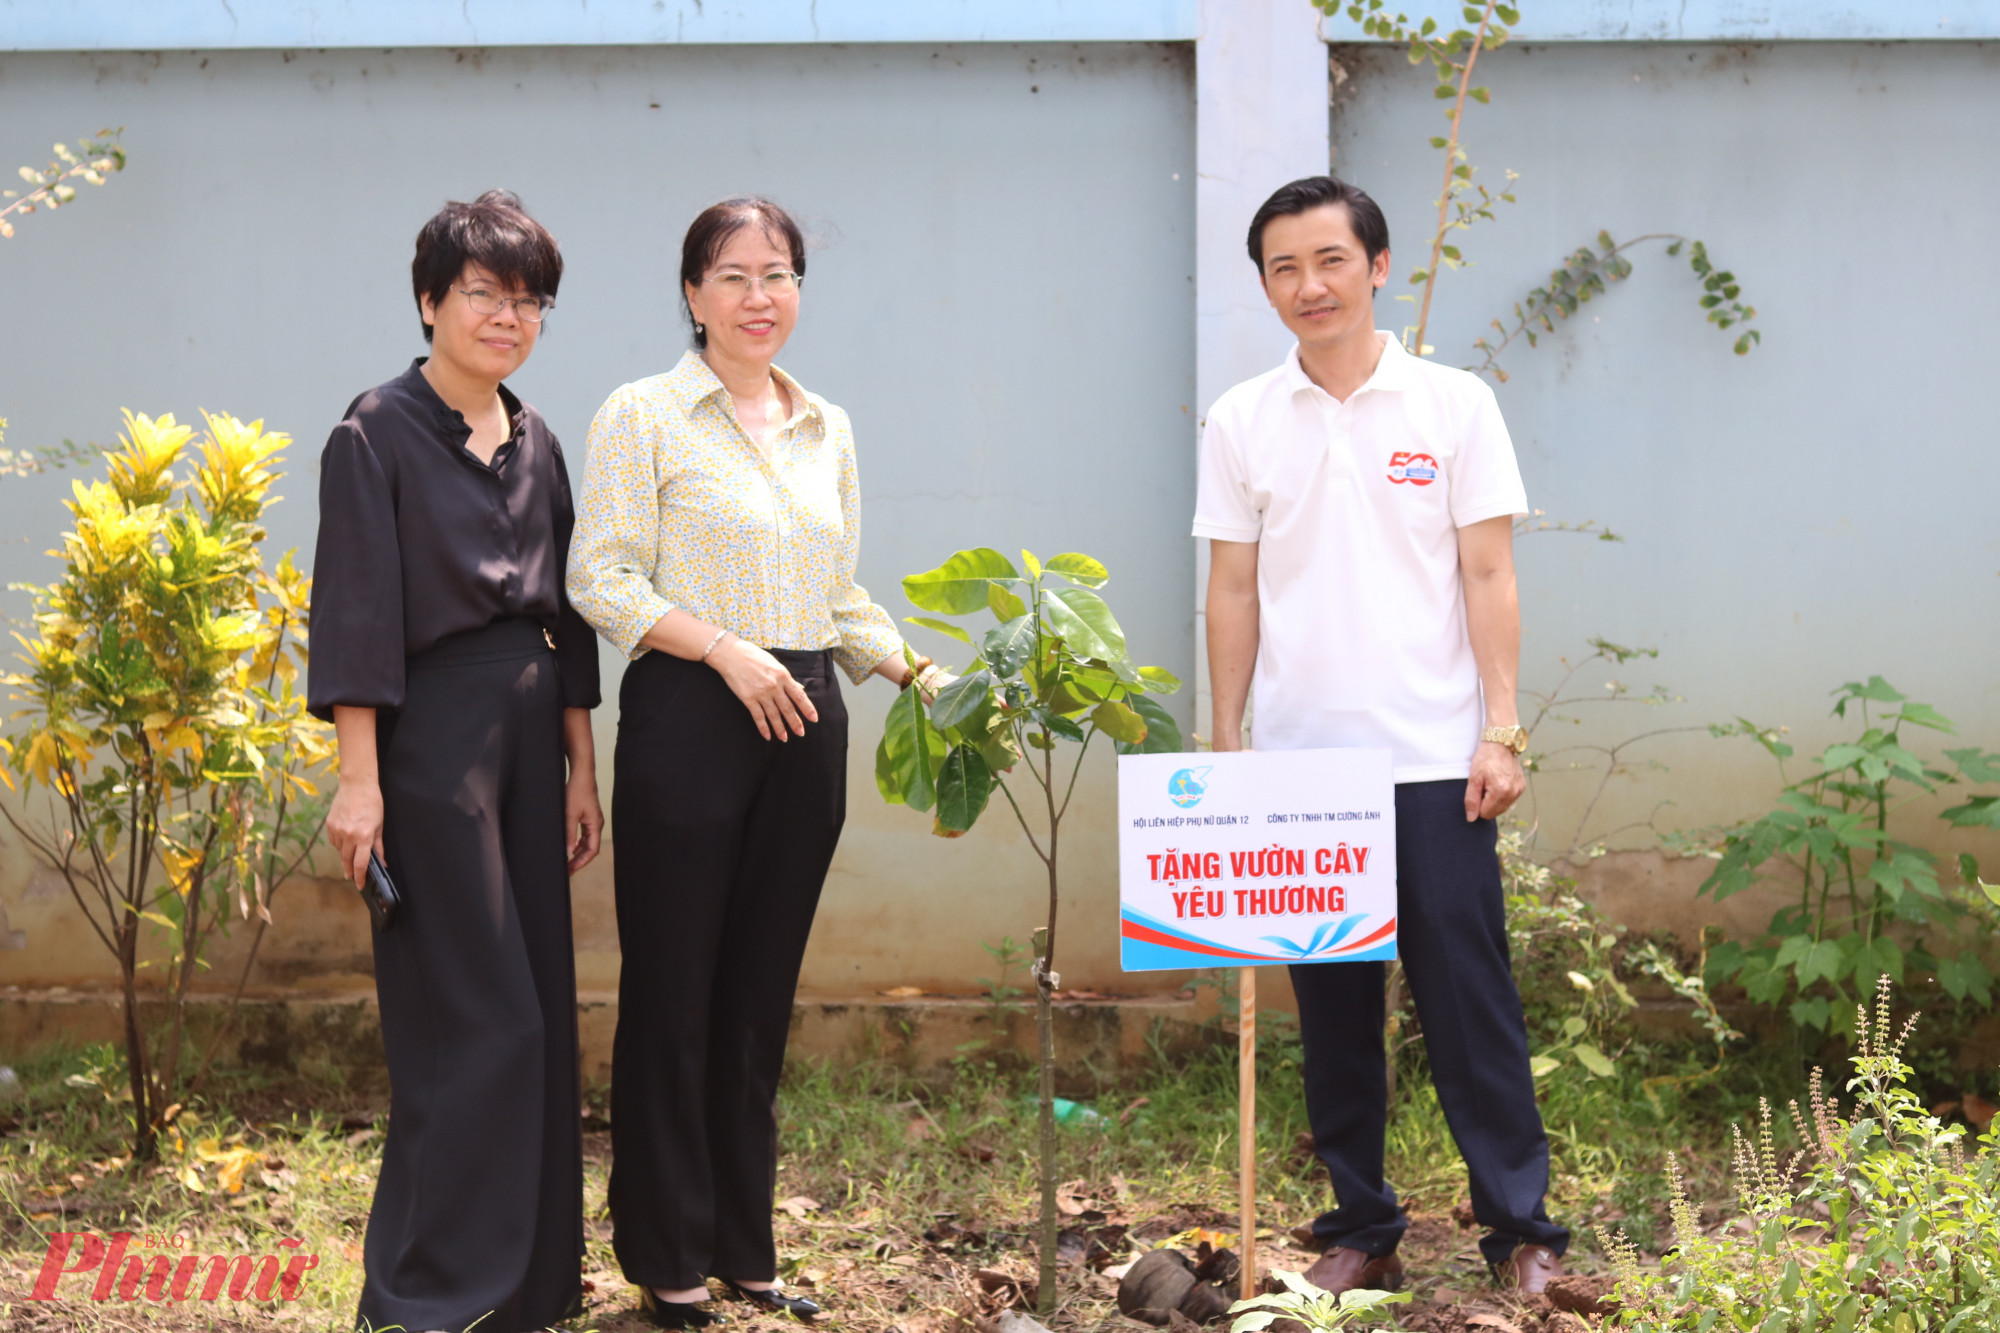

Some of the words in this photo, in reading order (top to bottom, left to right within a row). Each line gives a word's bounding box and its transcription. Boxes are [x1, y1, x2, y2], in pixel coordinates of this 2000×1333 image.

[1133, 817, 1147, 829] HỘI
[1148, 816, 1166, 828] LIÊN
[1167, 815, 1185, 828] HIỆP
[1186, 816, 1202, 827] PHỤ
[1203, 814, 1215, 826] NỮ
[1216, 814, 1237, 827] QUẬN
[1239, 815, 1249, 825] 12
[1267, 812, 1288, 824] CÔNG
[1290, 813, 1299, 823] TY
[1301, 813, 1322, 823] TNHH
[1324, 812, 1335, 822] TM
[1146, 847, 1221, 887] TẶNG
[1229, 843, 1306, 878] VƯỜN
[1315, 842, 1369, 876] CÂY
[1171, 885, 1225, 919] YÊU
[1233, 884, 1346, 917] THƯƠNG
